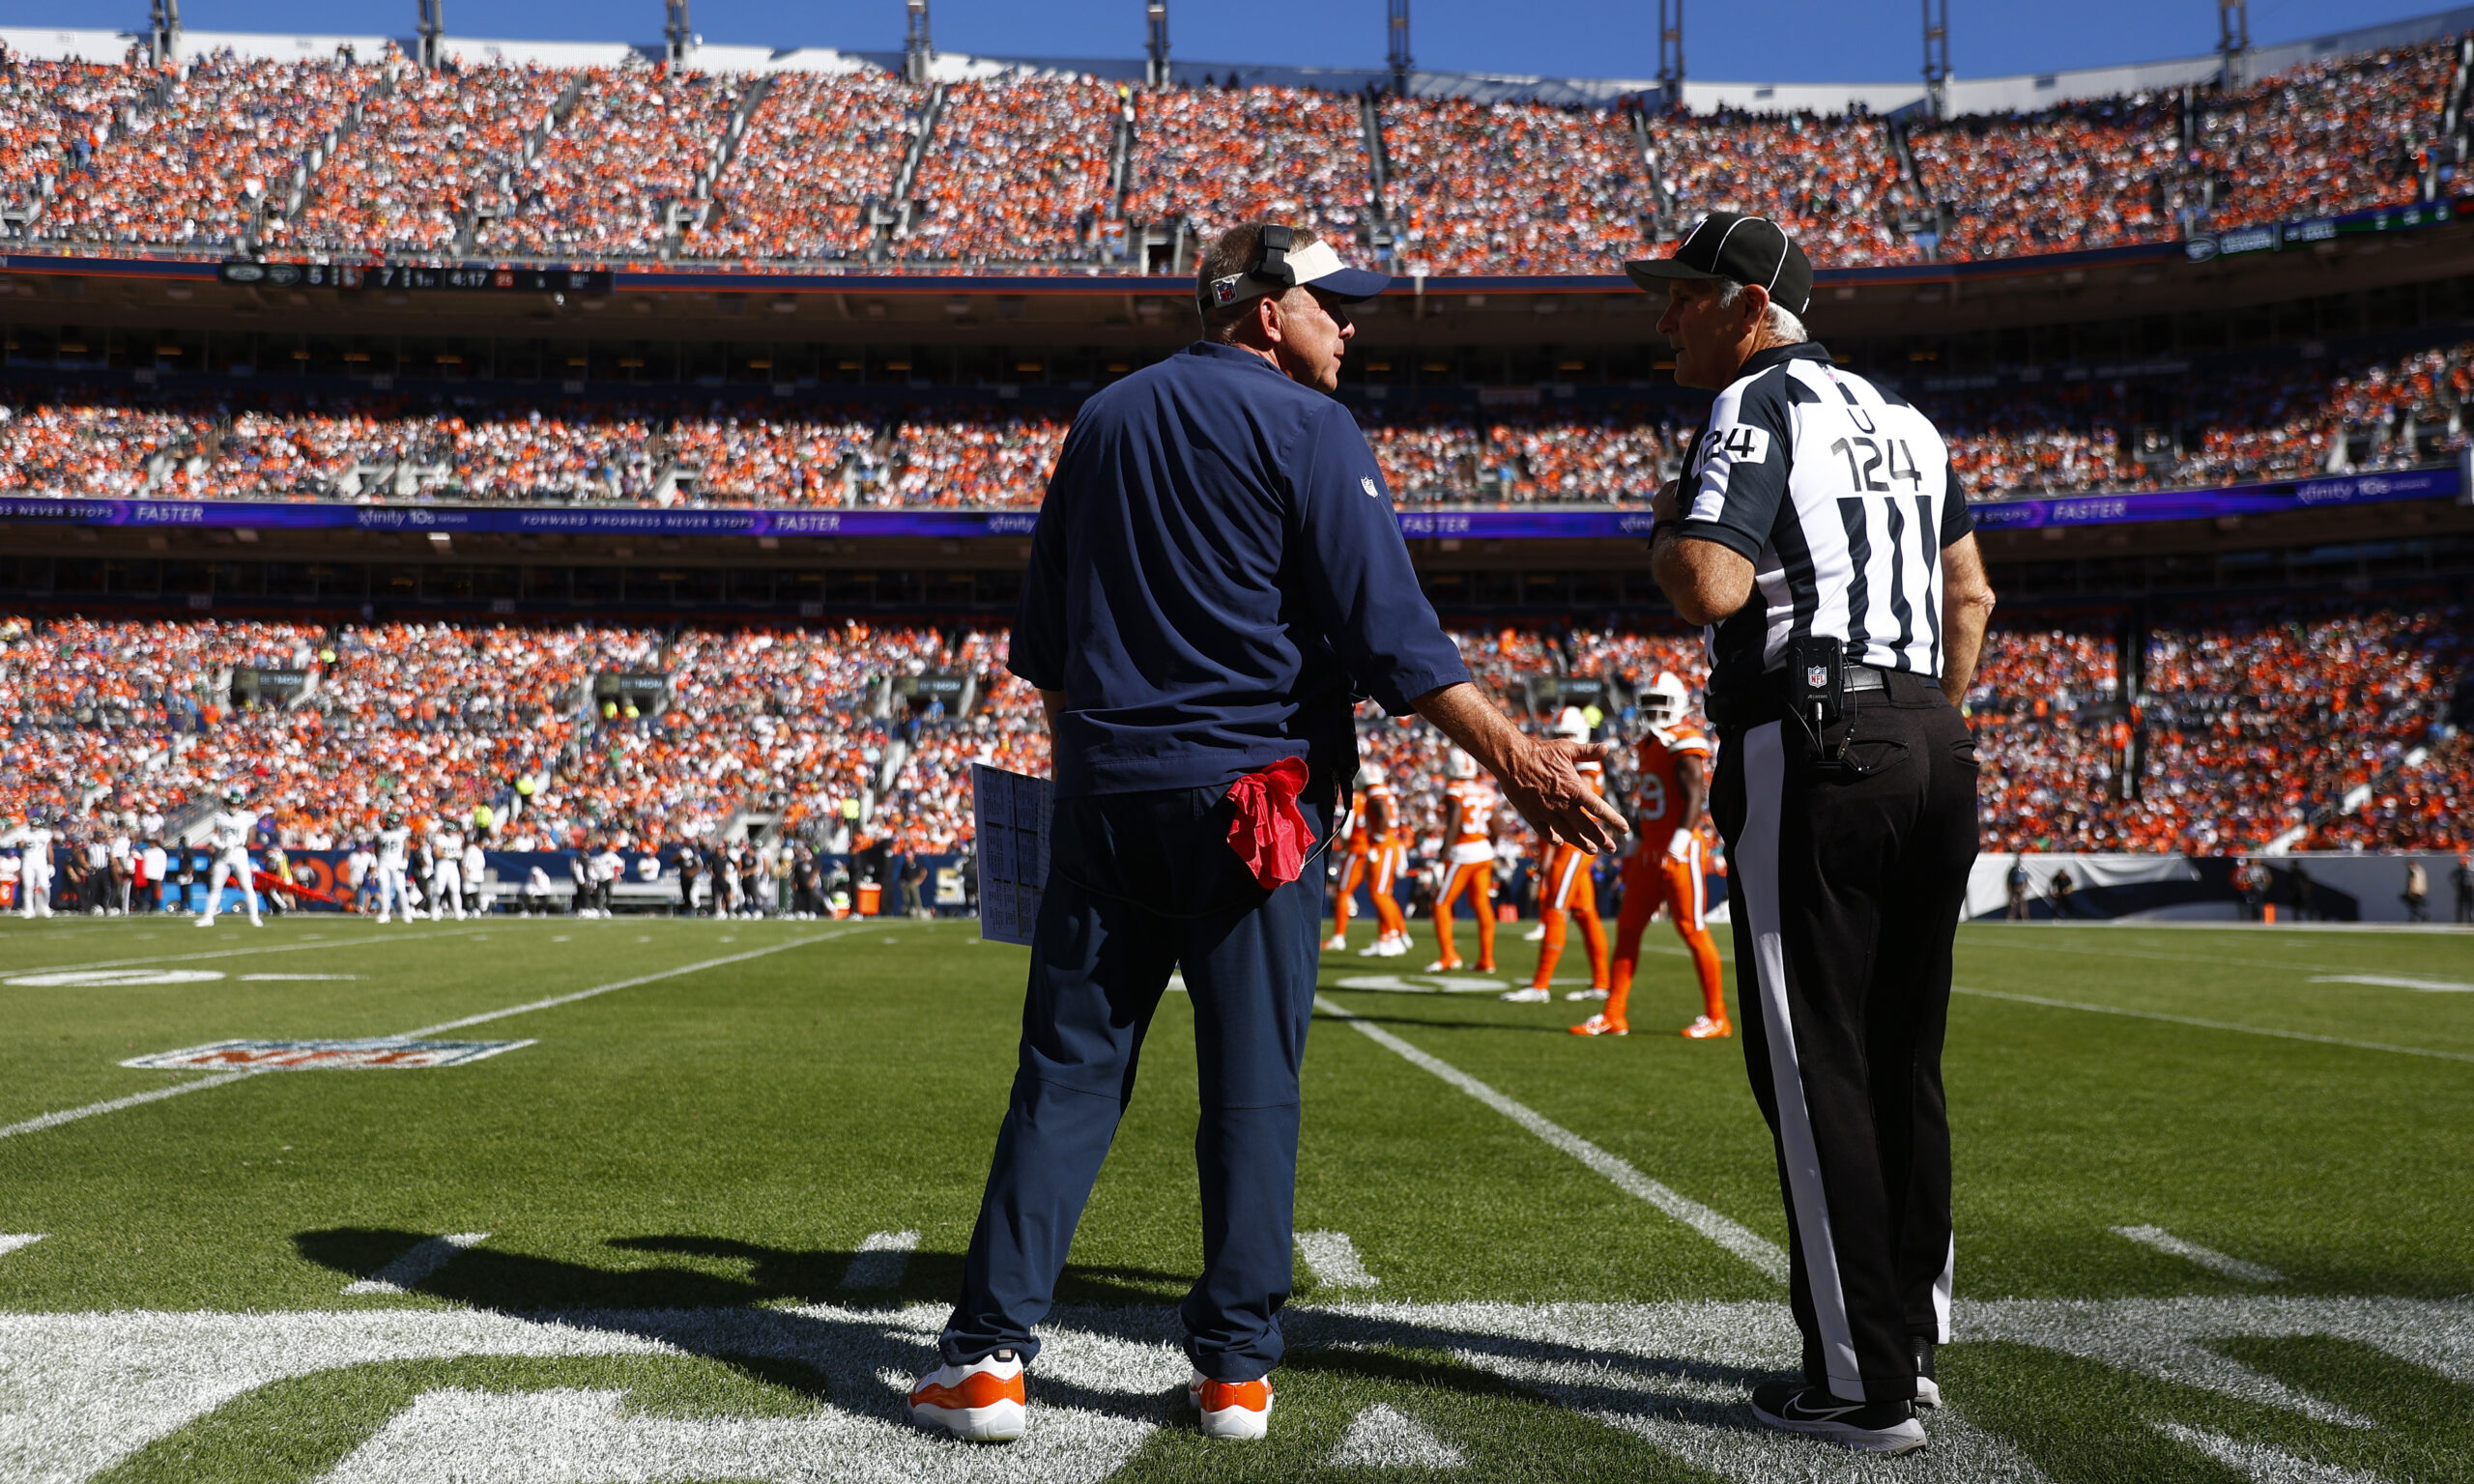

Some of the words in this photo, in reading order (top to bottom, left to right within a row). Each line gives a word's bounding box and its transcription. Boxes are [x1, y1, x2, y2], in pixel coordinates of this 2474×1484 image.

[1830, 437, 1922, 492] 124
[18, 504, 65, 517] NEVER
[69, 505, 113, 518] STOPS
[136, 504, 204, 522] FASTER
[358, 509, 405, 527] xfinity
[2053, 500, 2125, 520] FASTER
[522, 514, 588, 527] FORWARD
[666, 516, 708, 528] NEVER
[713, 516, 755, 528] STOPS
[775, 514, 841, 531] FASTER
[1401, 516, 1469, 533] FASTER
